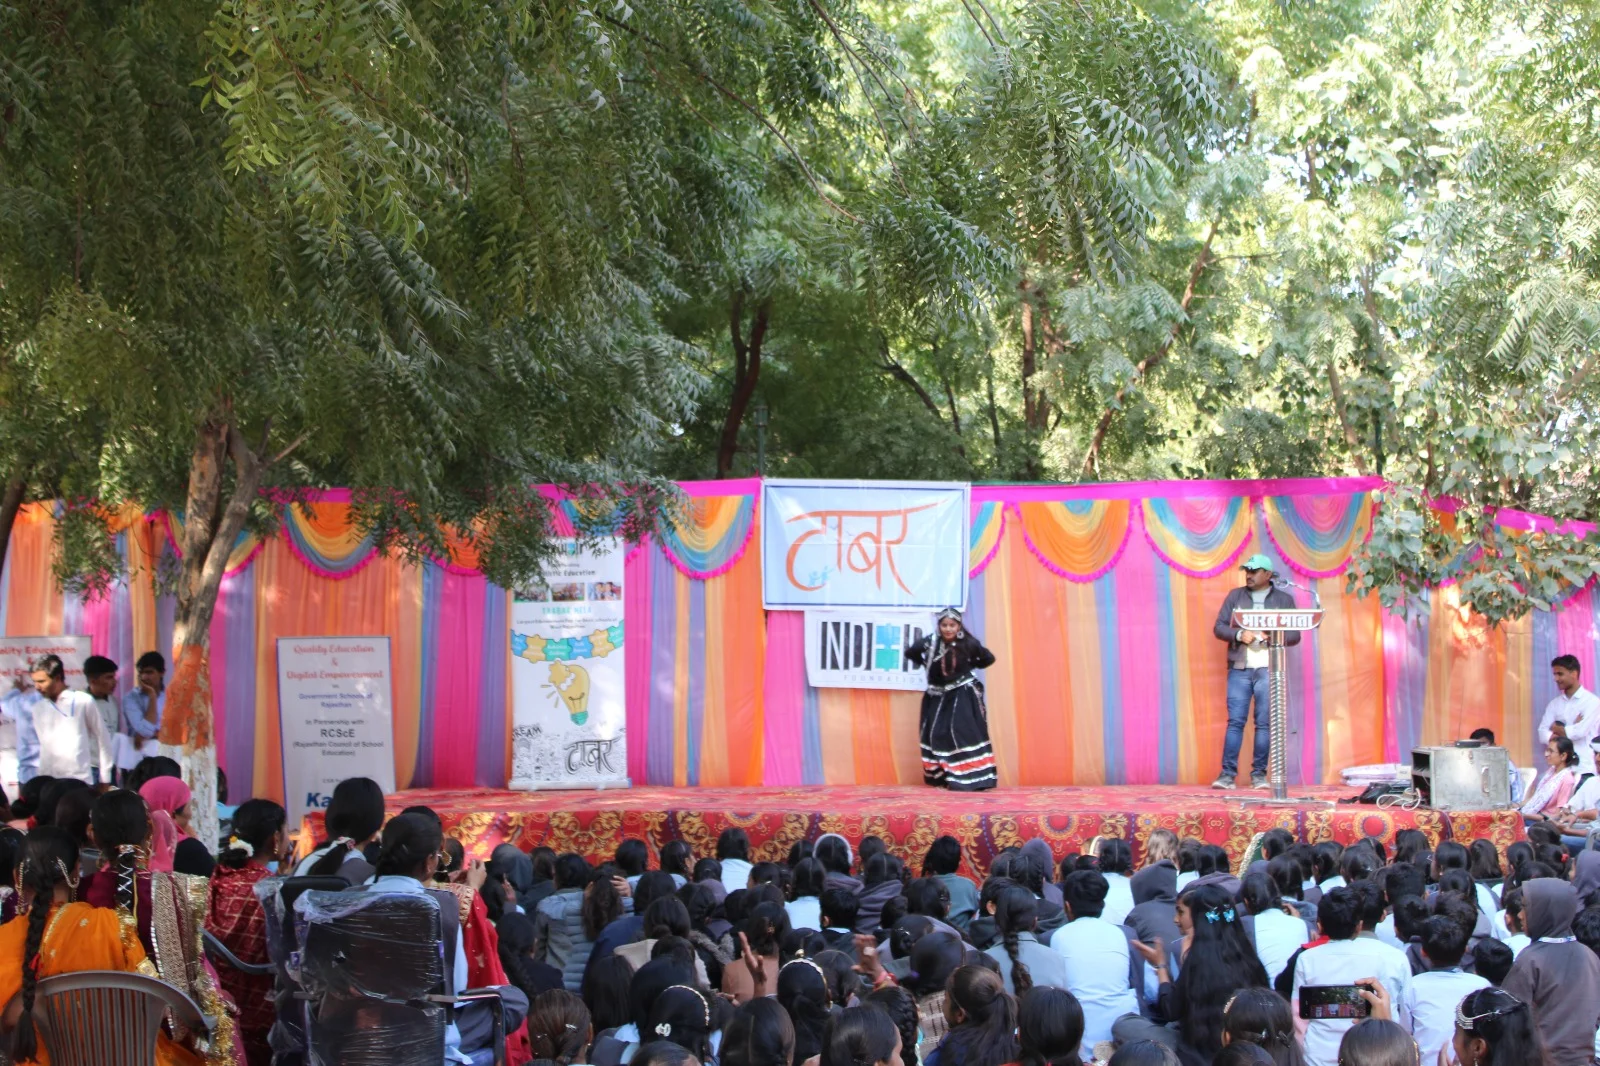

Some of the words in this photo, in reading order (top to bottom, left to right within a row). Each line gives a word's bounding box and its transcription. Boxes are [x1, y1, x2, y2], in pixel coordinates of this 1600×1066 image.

[785, 499, 948, 596] टाबर
[1242, 613, 1279, 628] भारत
[1279, 613, 1314, 628] माता
[294, 646, 327, 655] Quality
[329, 645, 374, 653] Education
[319, 670, 384, 679] Empowerment
[843, 674, 924, 683] FOUNDATION
[320, 729, 356, 738] RCScE
